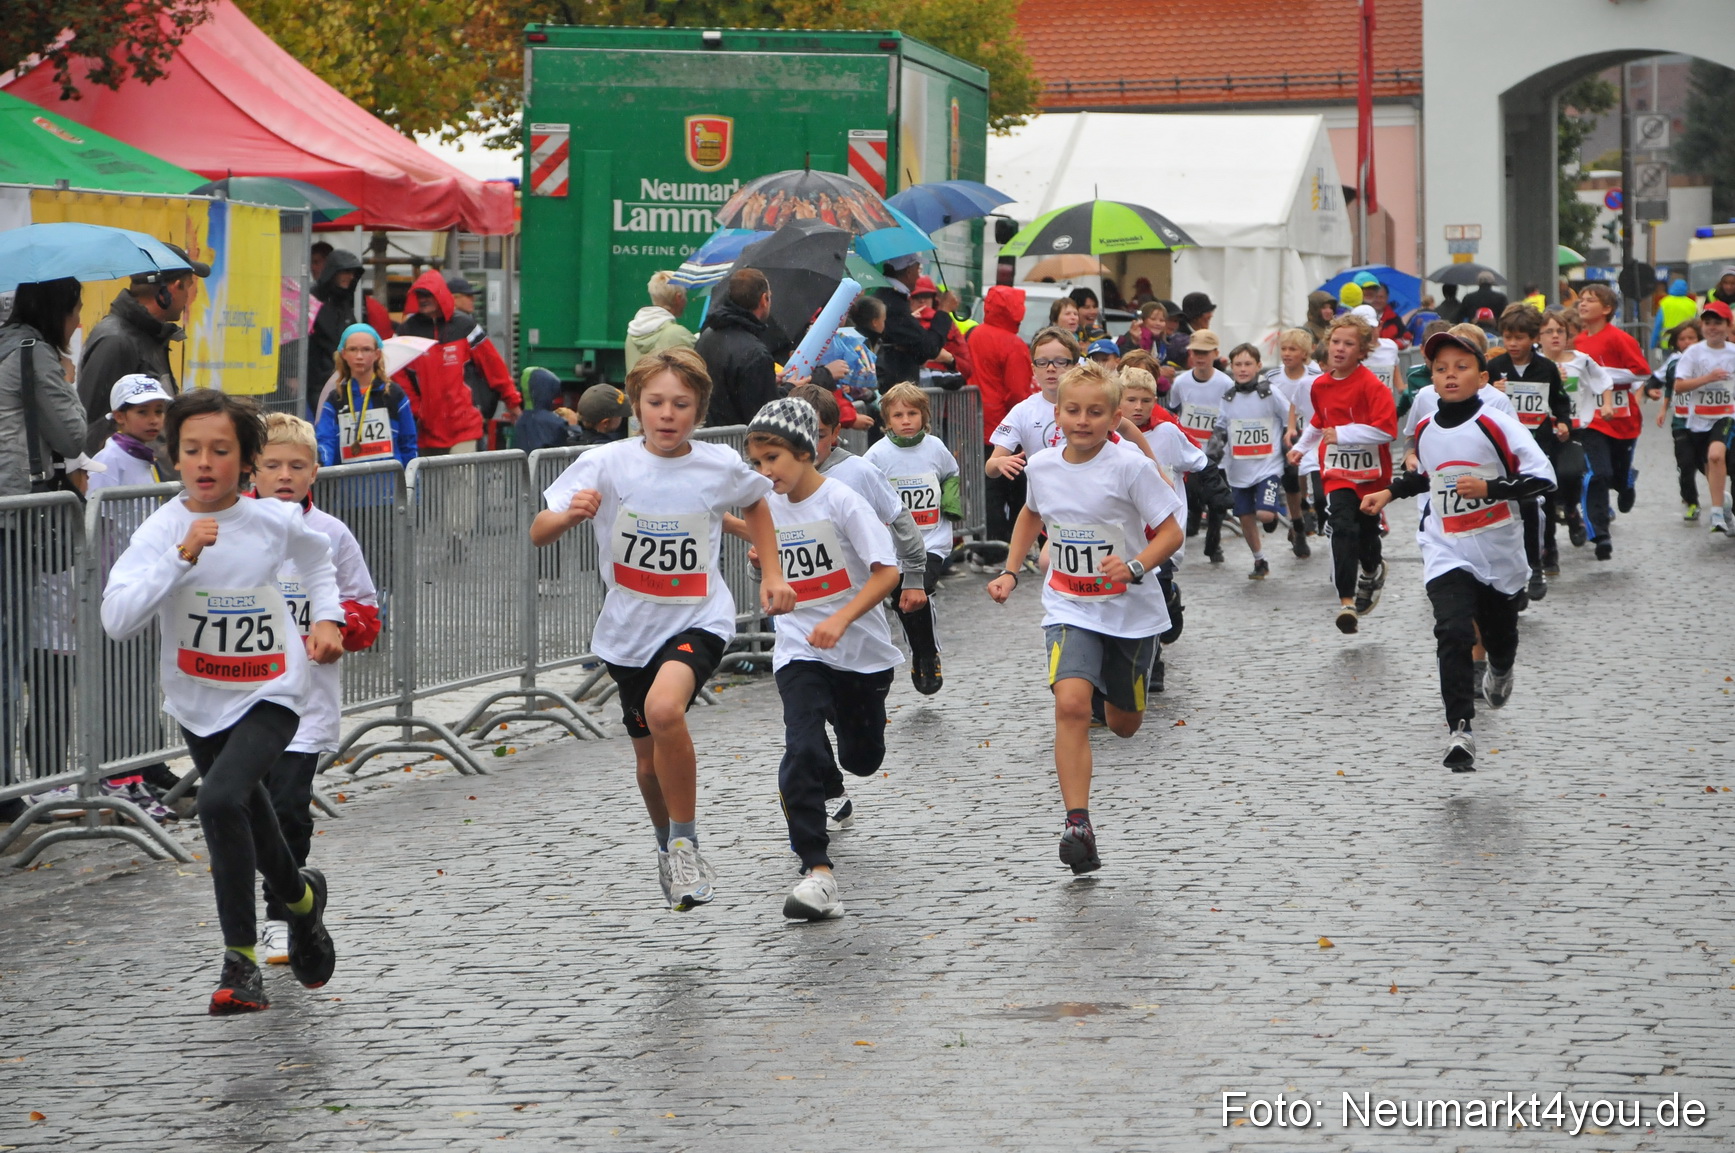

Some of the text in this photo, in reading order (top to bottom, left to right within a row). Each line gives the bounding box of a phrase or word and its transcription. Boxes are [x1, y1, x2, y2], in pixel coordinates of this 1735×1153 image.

[613, 200, 717, 233] Lamm
[613, 245, 638, 255] DAS
[642, 245, 675, 256] FEINE
[1698, 390, 1731, 405] 7305
[344, 422, 386, 444] 742
[1236, 429, 1269, 444] 7205
[1329, 452, 1373, 470] 7070
[897, 488, 936, 509] 022
[636, 519, 679, 531] BOCK
[1060, 529, 1095, 538] BOCK
[622, 532, 697, 571] 7256
[1068, 579, 1100, 592] Lukas
[208, 596, 255, 607] BOCK
[188, 613, 275, 653] 7125
[195, 657, 269, 678] Cornelius
